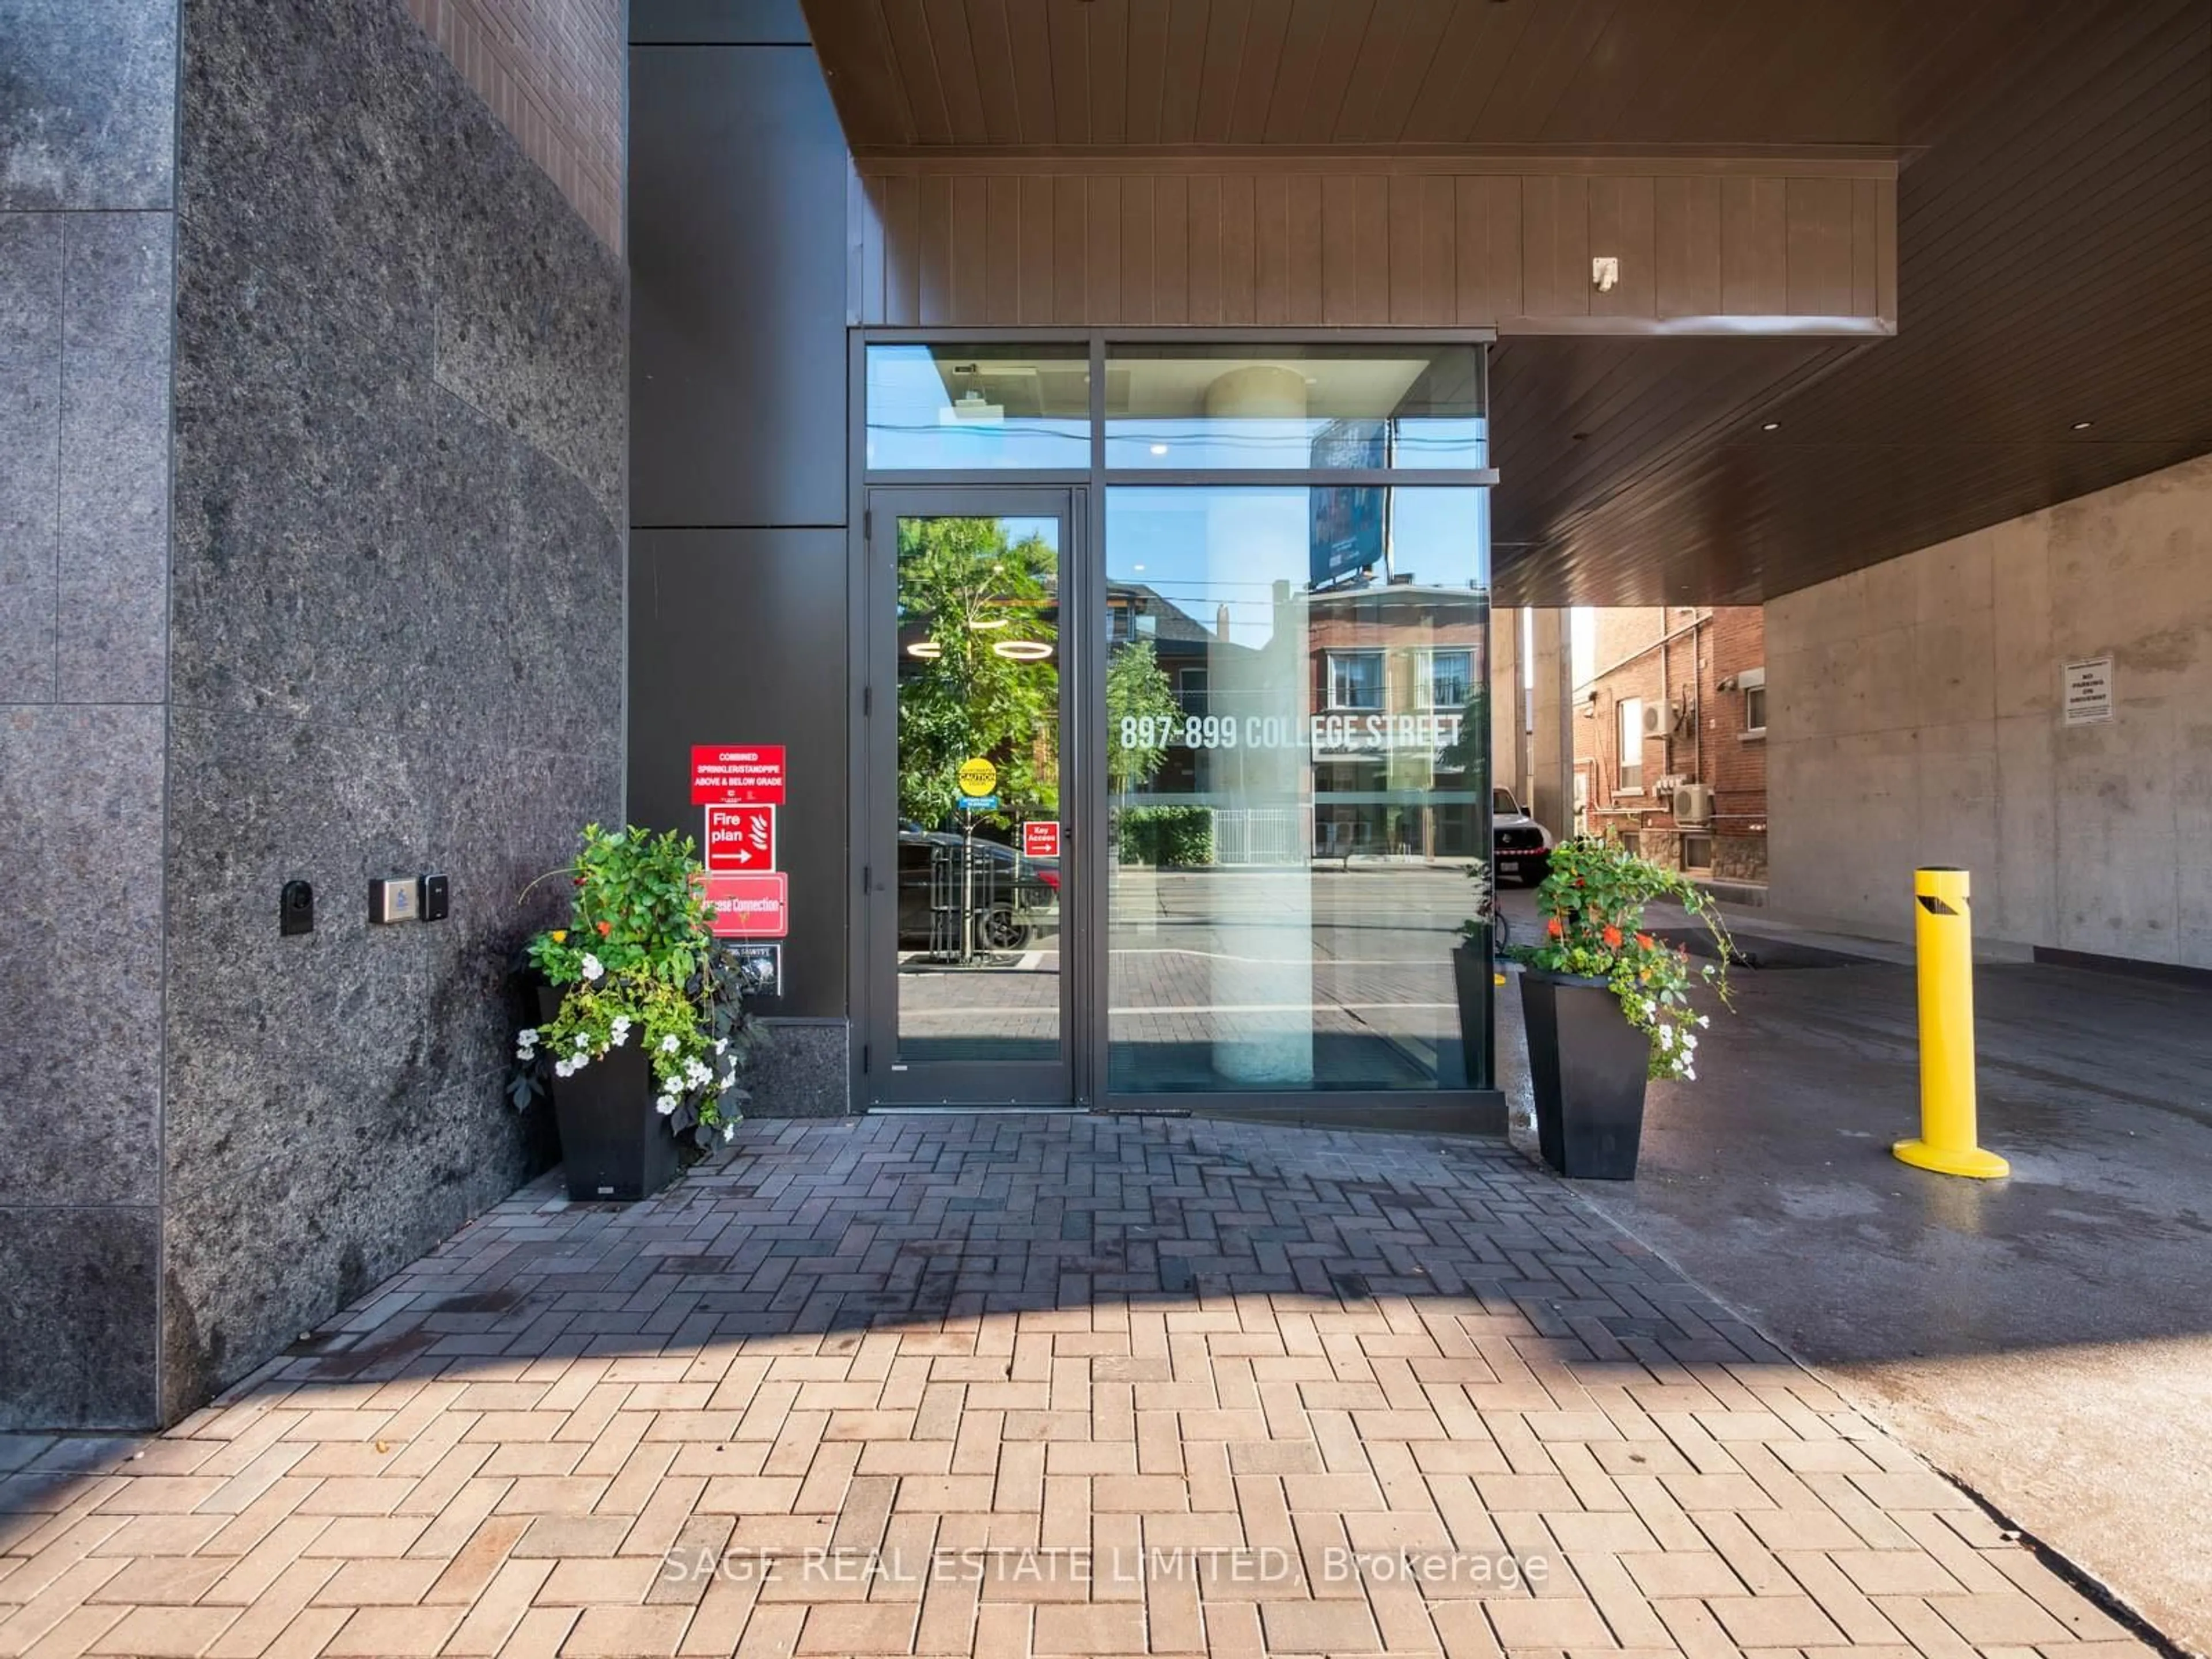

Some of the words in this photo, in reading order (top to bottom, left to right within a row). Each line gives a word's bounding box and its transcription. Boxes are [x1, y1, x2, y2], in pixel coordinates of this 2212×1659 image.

[2072, 679, 2104, 688] PARKING
[1120, 715, 1237, 749] 897-899
[1245, 715, 1358, 748] COLLEGE
[1366, 714, 1464, 747] STREET
[719, 752, 759, 761] COMBINED
[695, 777, 720, 786] ABOVE
[721, 778, 728, 786] &
[729, 778, 755, 786] BELOW
[756, 777, 782, 786] GRADE
[713, 812, 740, 825] Fire
[711, 828, 743, 844] plan
[1034, 827, 1049, 835] Key
[733, 896, 779, 912] Connection
